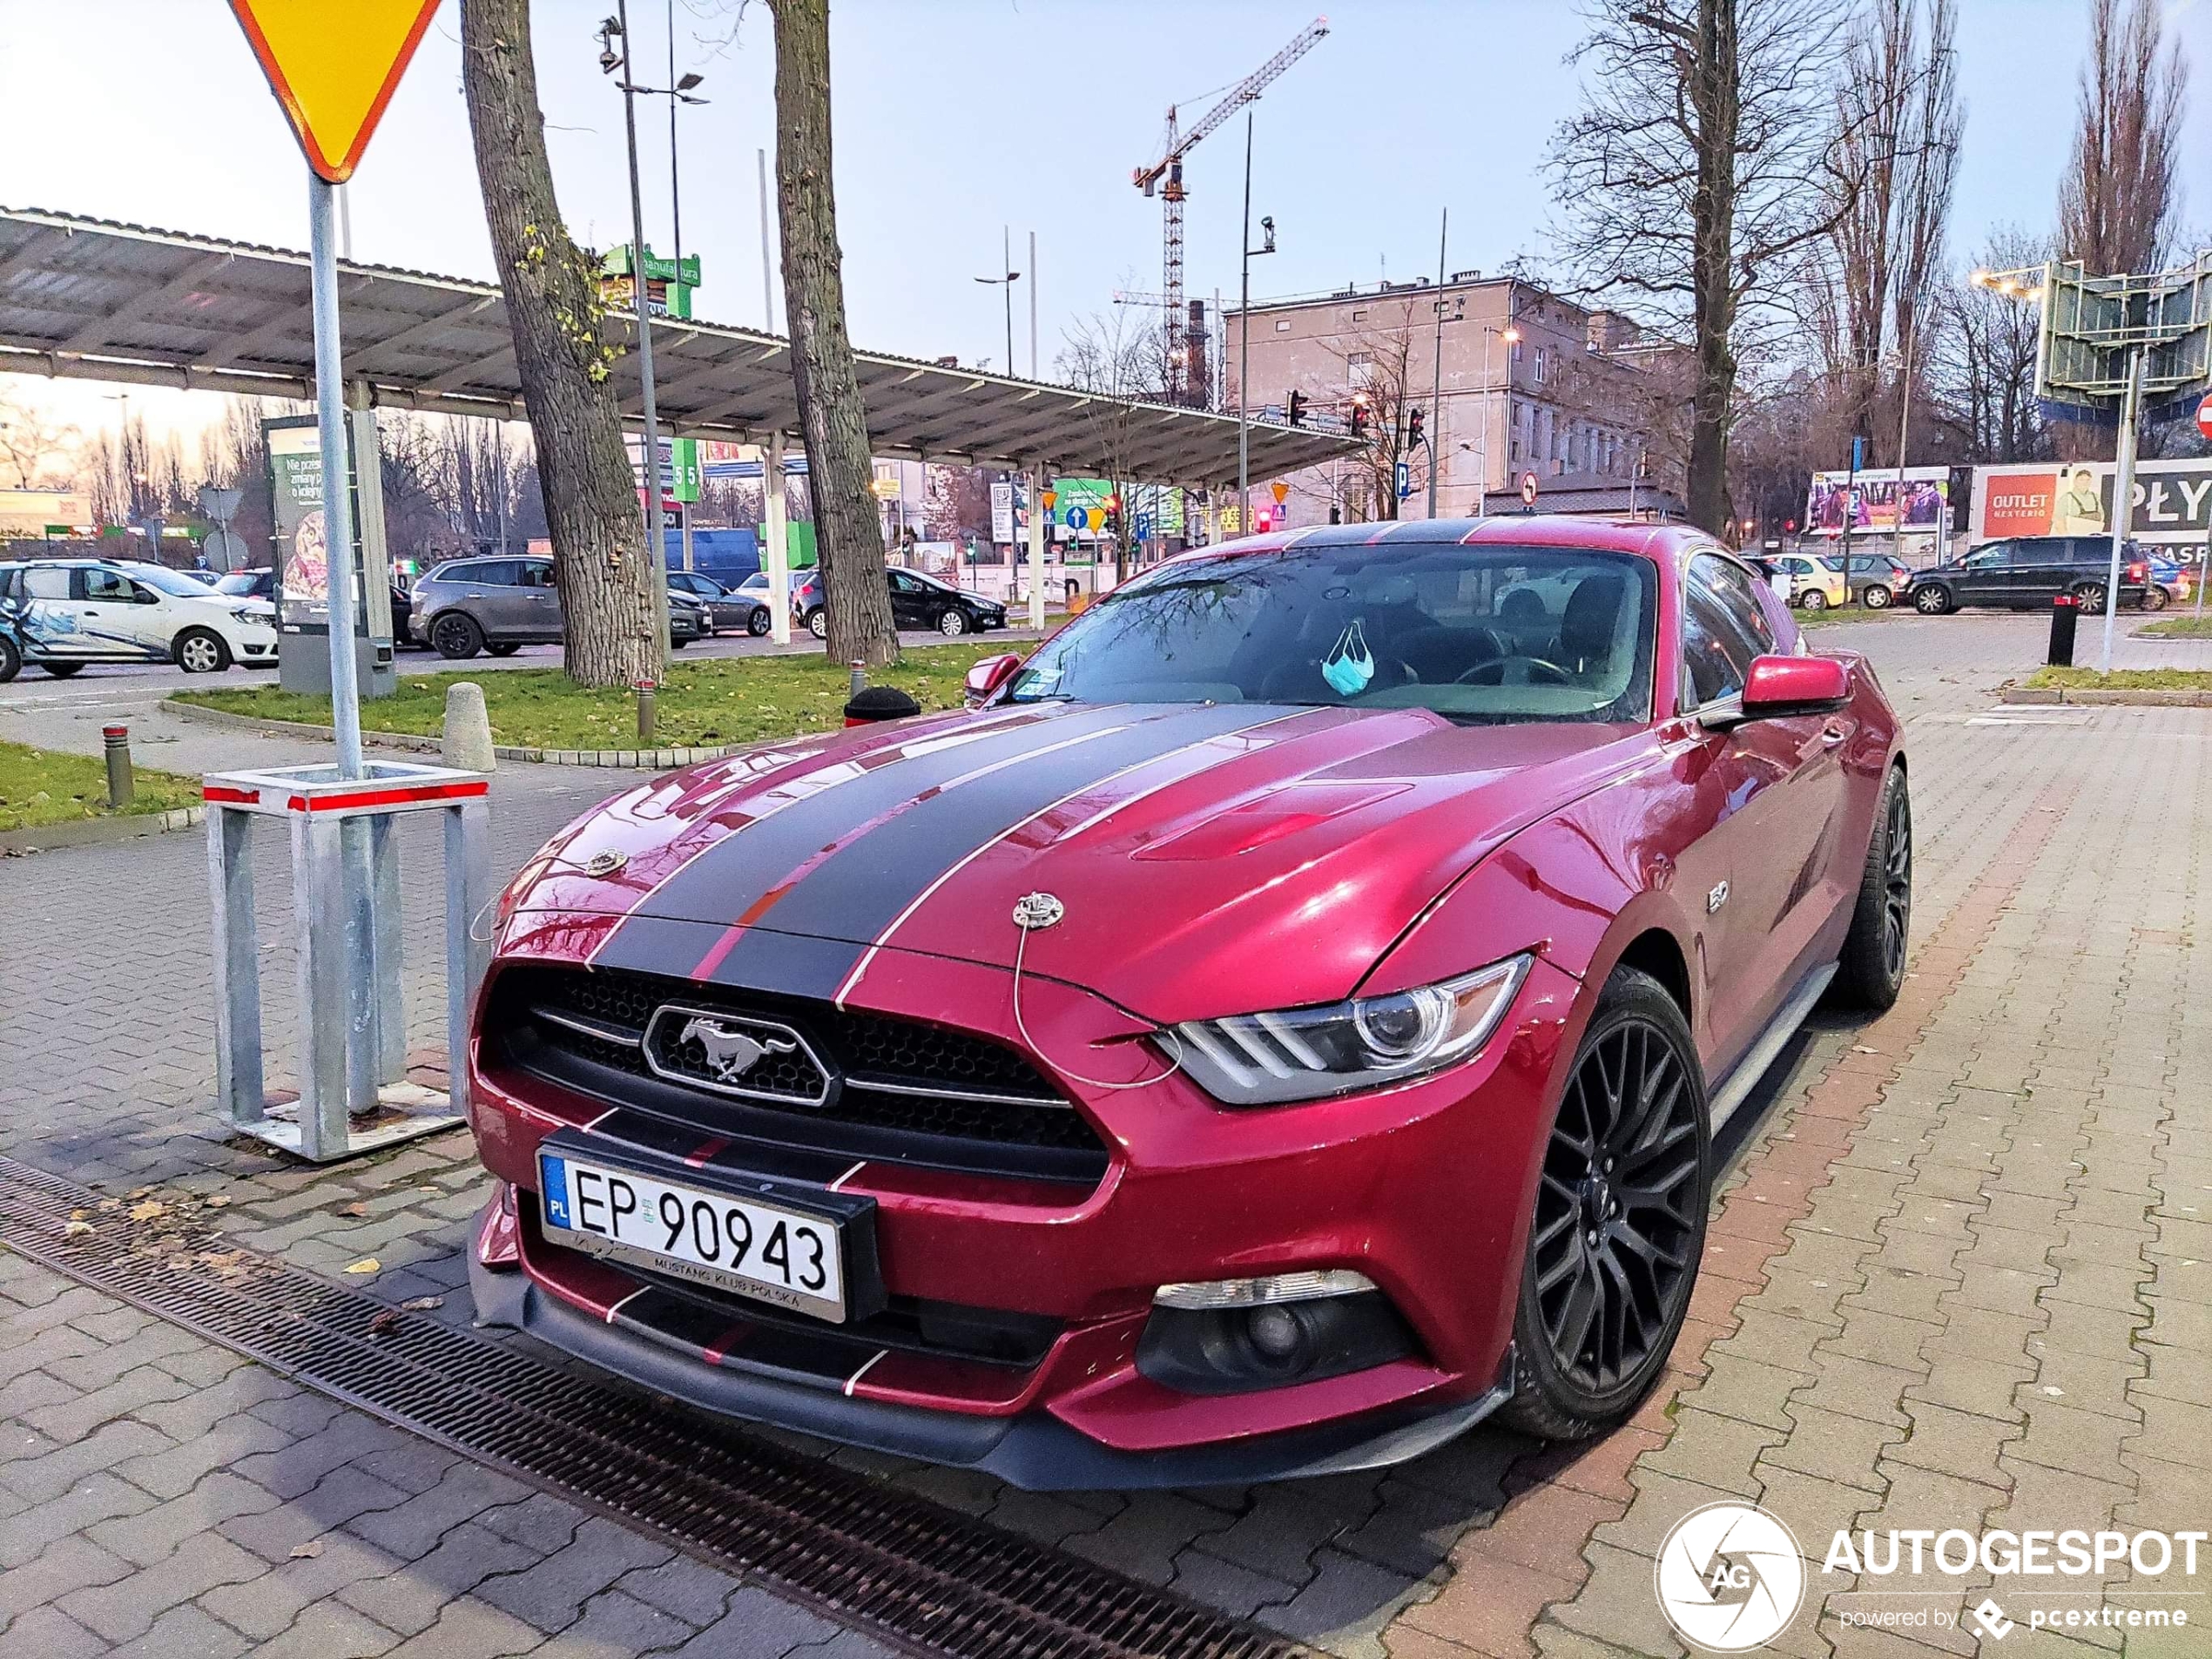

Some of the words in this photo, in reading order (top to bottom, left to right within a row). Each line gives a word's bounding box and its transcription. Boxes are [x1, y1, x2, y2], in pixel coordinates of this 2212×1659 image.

[676, 466, 683, 485] 5
[688, 466, 696, 485] 5
[1399, 466, 1406, 494] P
[1993, 495, 2047, 509] OUTLET
[1993, 509, 2046, 518] NEXTERIO
[550, 1199, 568, 1218] PL
[576, 1170, 637, 1238] EP
[659, 1191, 826, 1291] 90943
[654, 1257, 711, 1282] MUSTANG
[714, 1274, 747, 1292] KLUB
[751, 1284, 800, 1308] POLSKA
